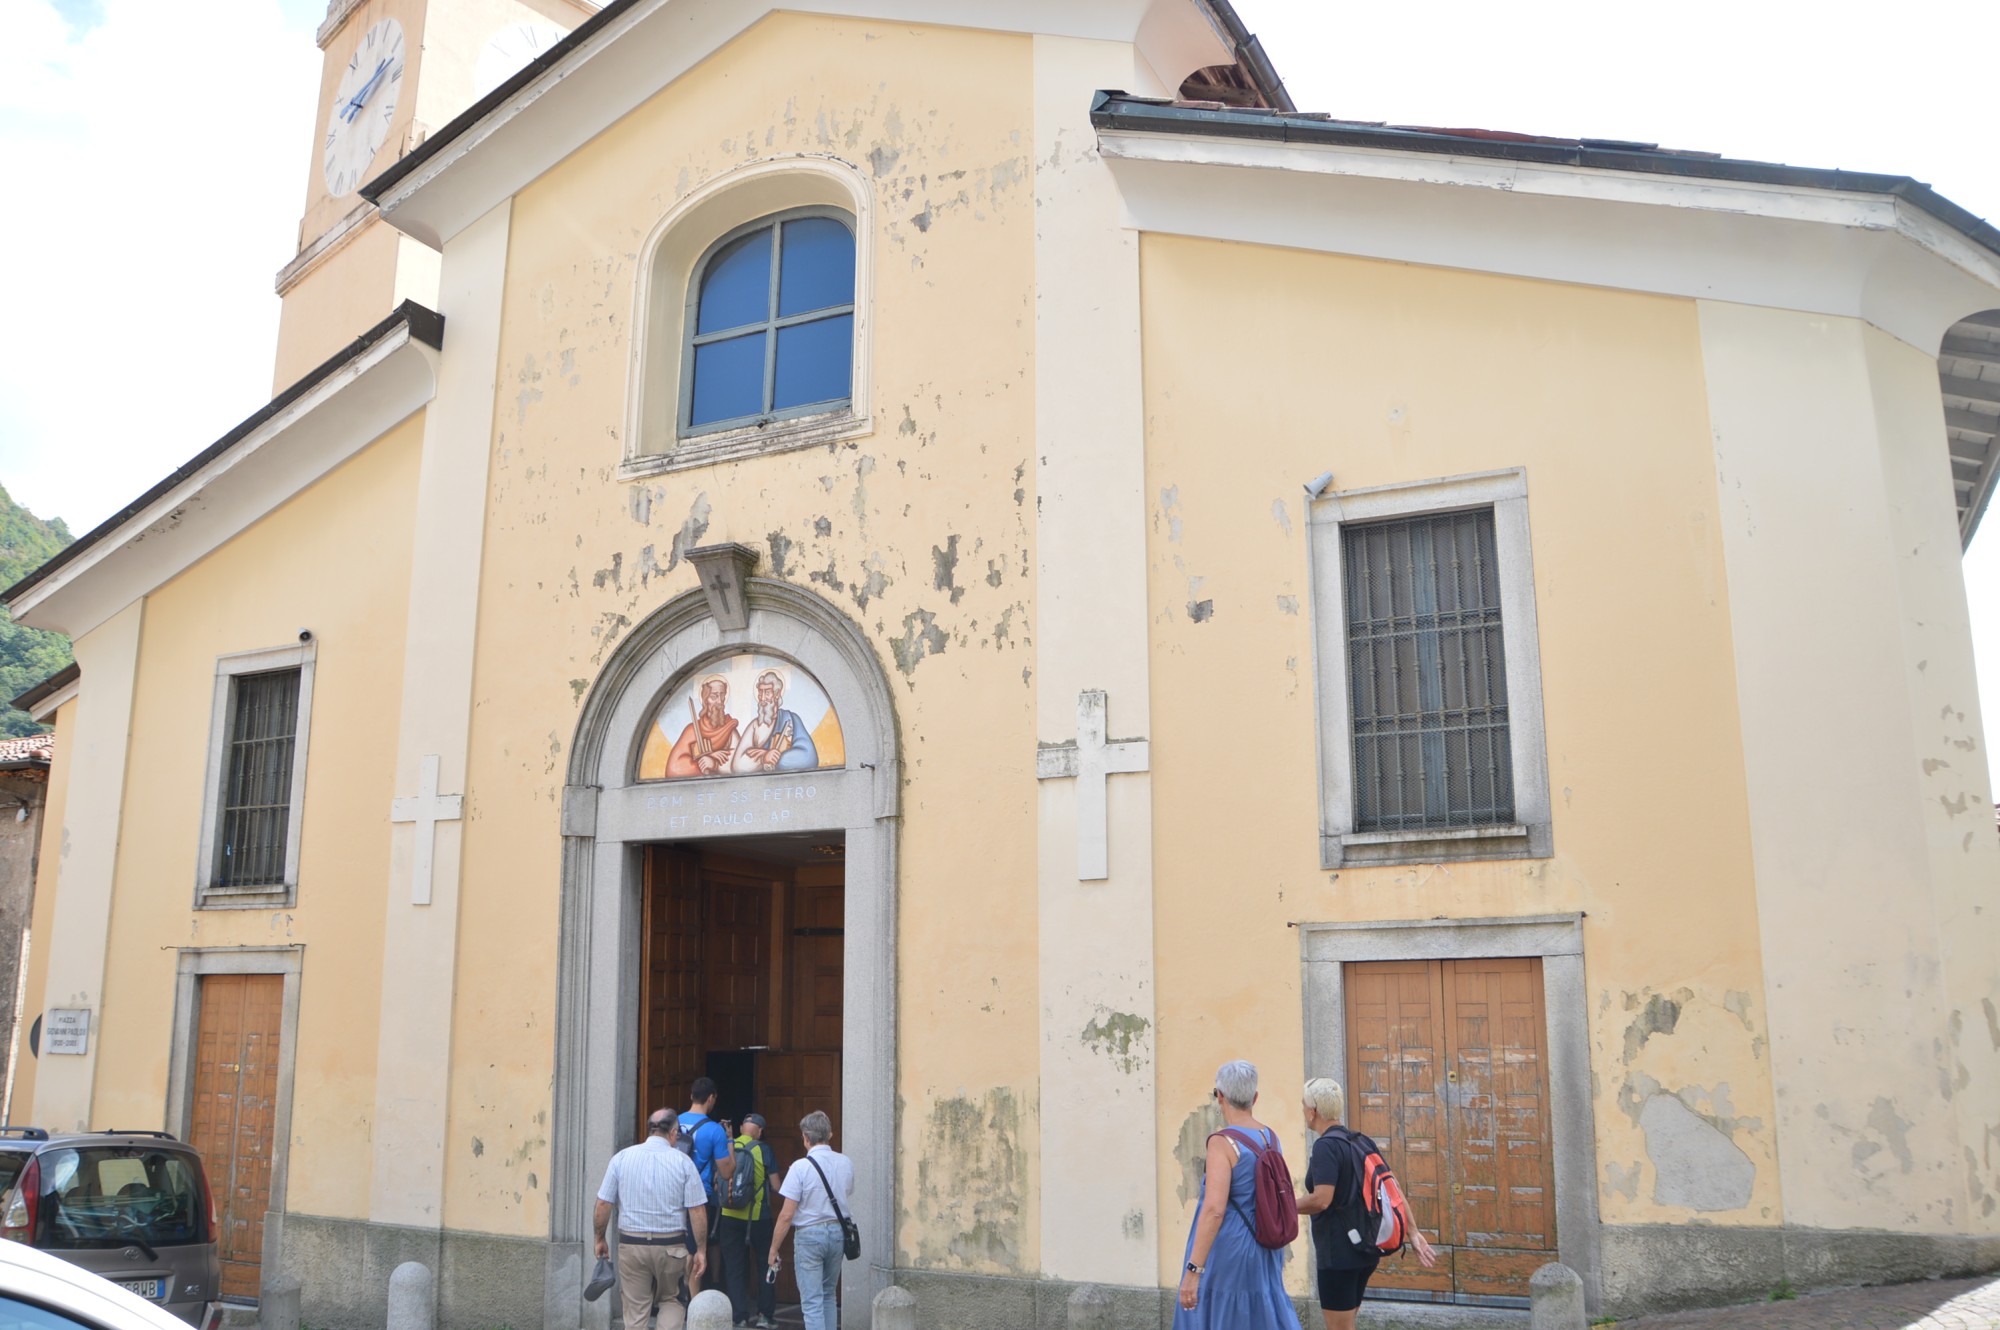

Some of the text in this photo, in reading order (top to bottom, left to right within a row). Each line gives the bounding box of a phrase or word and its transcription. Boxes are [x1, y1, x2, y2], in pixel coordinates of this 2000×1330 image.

[696, 791, 717, 805] ET
[730, 789, 749, 803] SS
[670, 809, 790, 828] ET PAULO AP
[58, 1016, 76, 1024] PIAZZA
